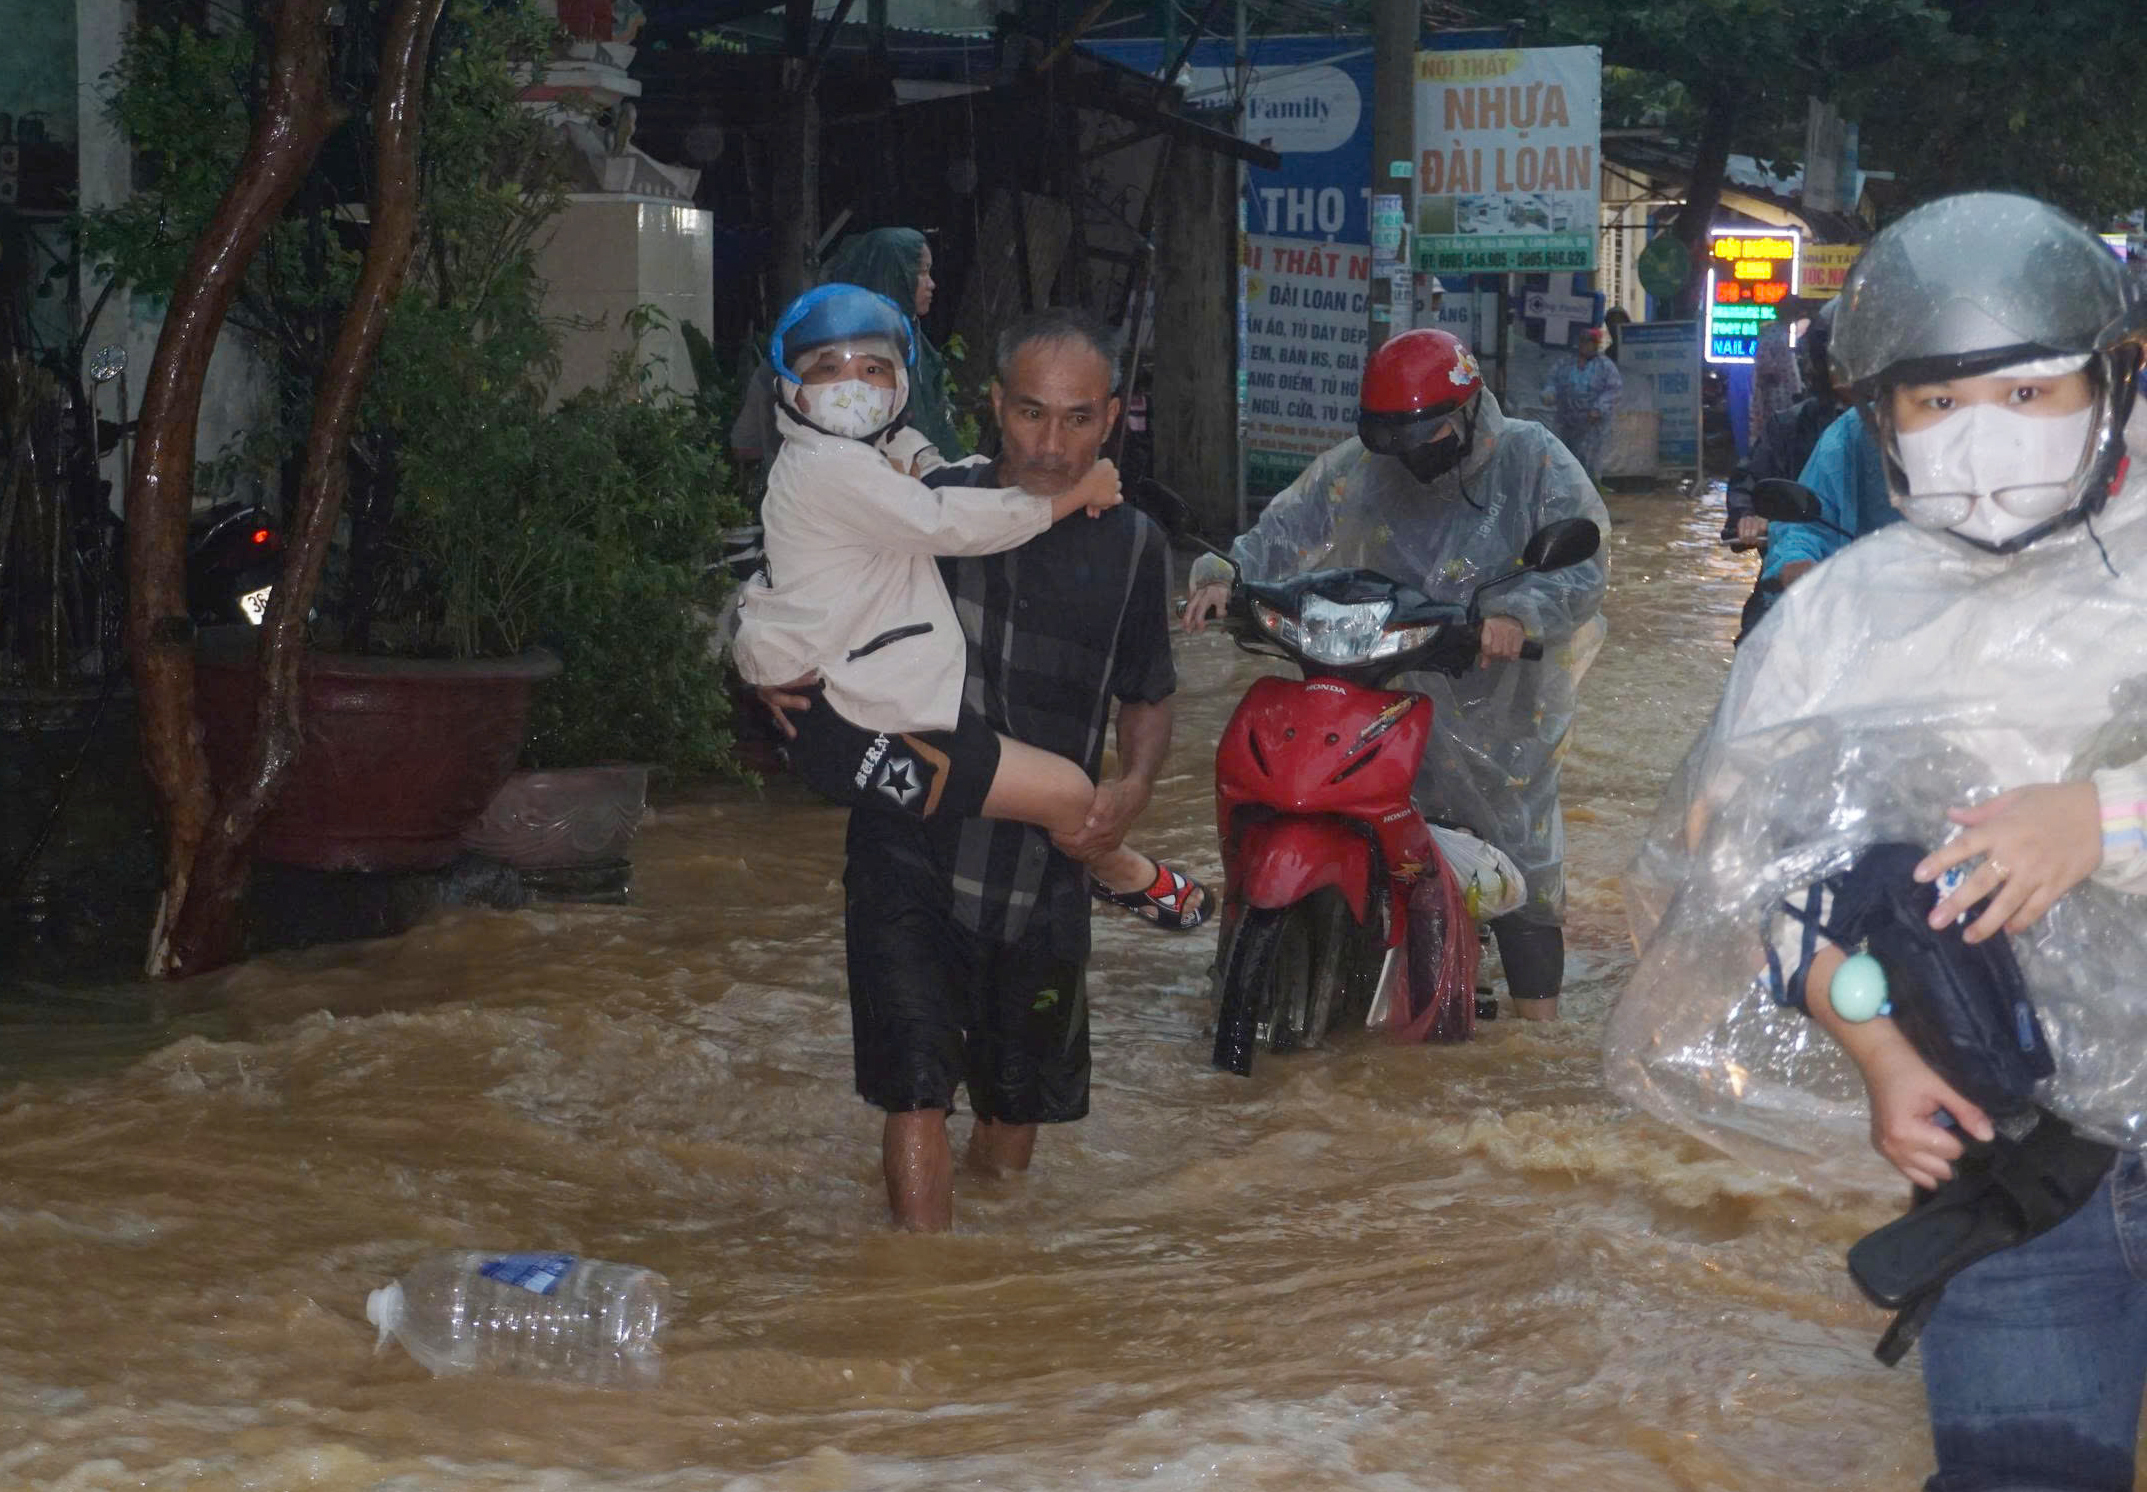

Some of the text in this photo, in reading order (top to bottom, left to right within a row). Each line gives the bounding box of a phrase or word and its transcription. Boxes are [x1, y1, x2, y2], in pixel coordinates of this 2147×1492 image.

[1249, 95, 1330, 123] Family
[1444, 81, 1570, 134] NHỰA
[1421, 138, 1592, 194] ĐÀI LOAN
[1259, 187, 1346, 243] THỌ
[1272, 244, 1341, 278] THẤT
[1269, 281, 1298, 306] ĐÀI
[1302, 287, 1346, 311] LOAN
[1713, 339, 1747, 355] NAIL
[1304, 682, 1347, 696] HONDA
[1382, 807, 1412, 824] HONDA
